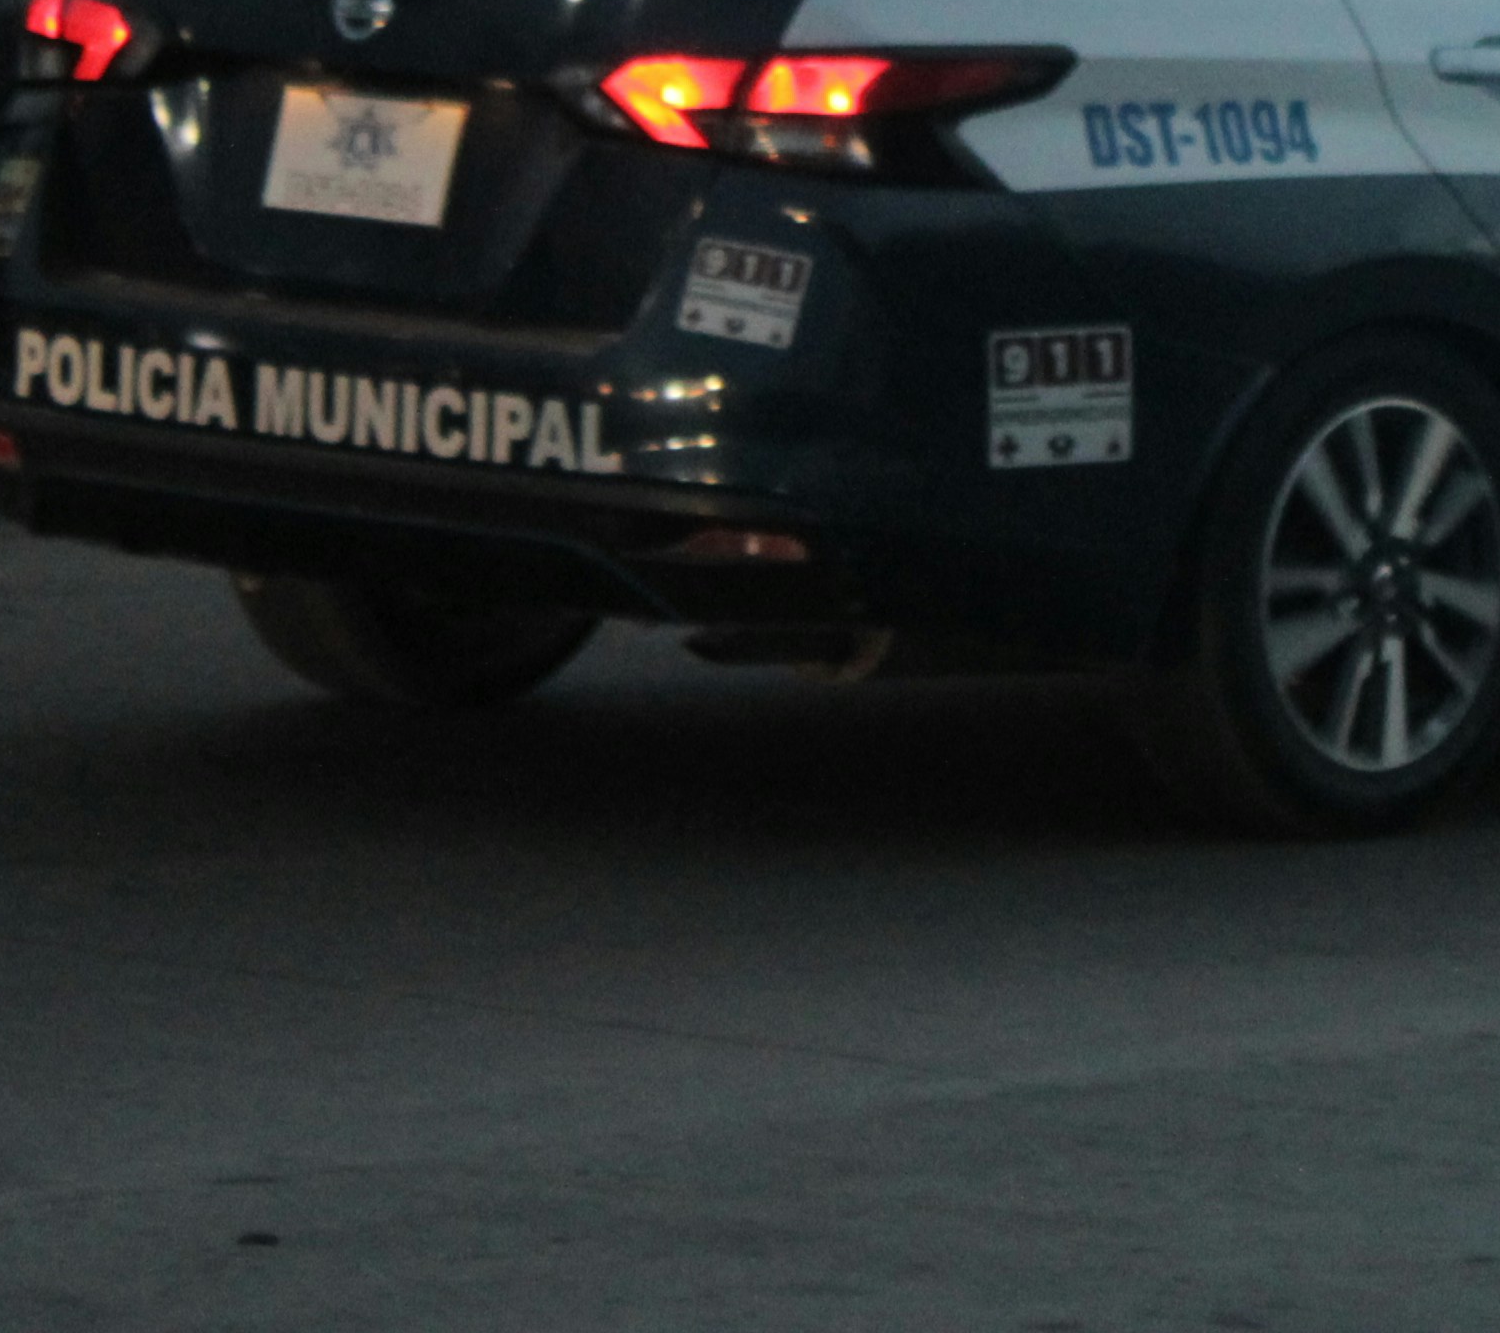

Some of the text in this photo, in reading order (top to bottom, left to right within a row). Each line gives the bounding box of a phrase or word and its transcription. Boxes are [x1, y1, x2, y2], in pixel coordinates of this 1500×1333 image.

[1082, 99, 1320, 168] DST-1094
[703, 247, 795, 289] 911
[1002, 338, 1116, 384] 911
[14, 328, 623, 474] POLICIA MUNICIPAL
